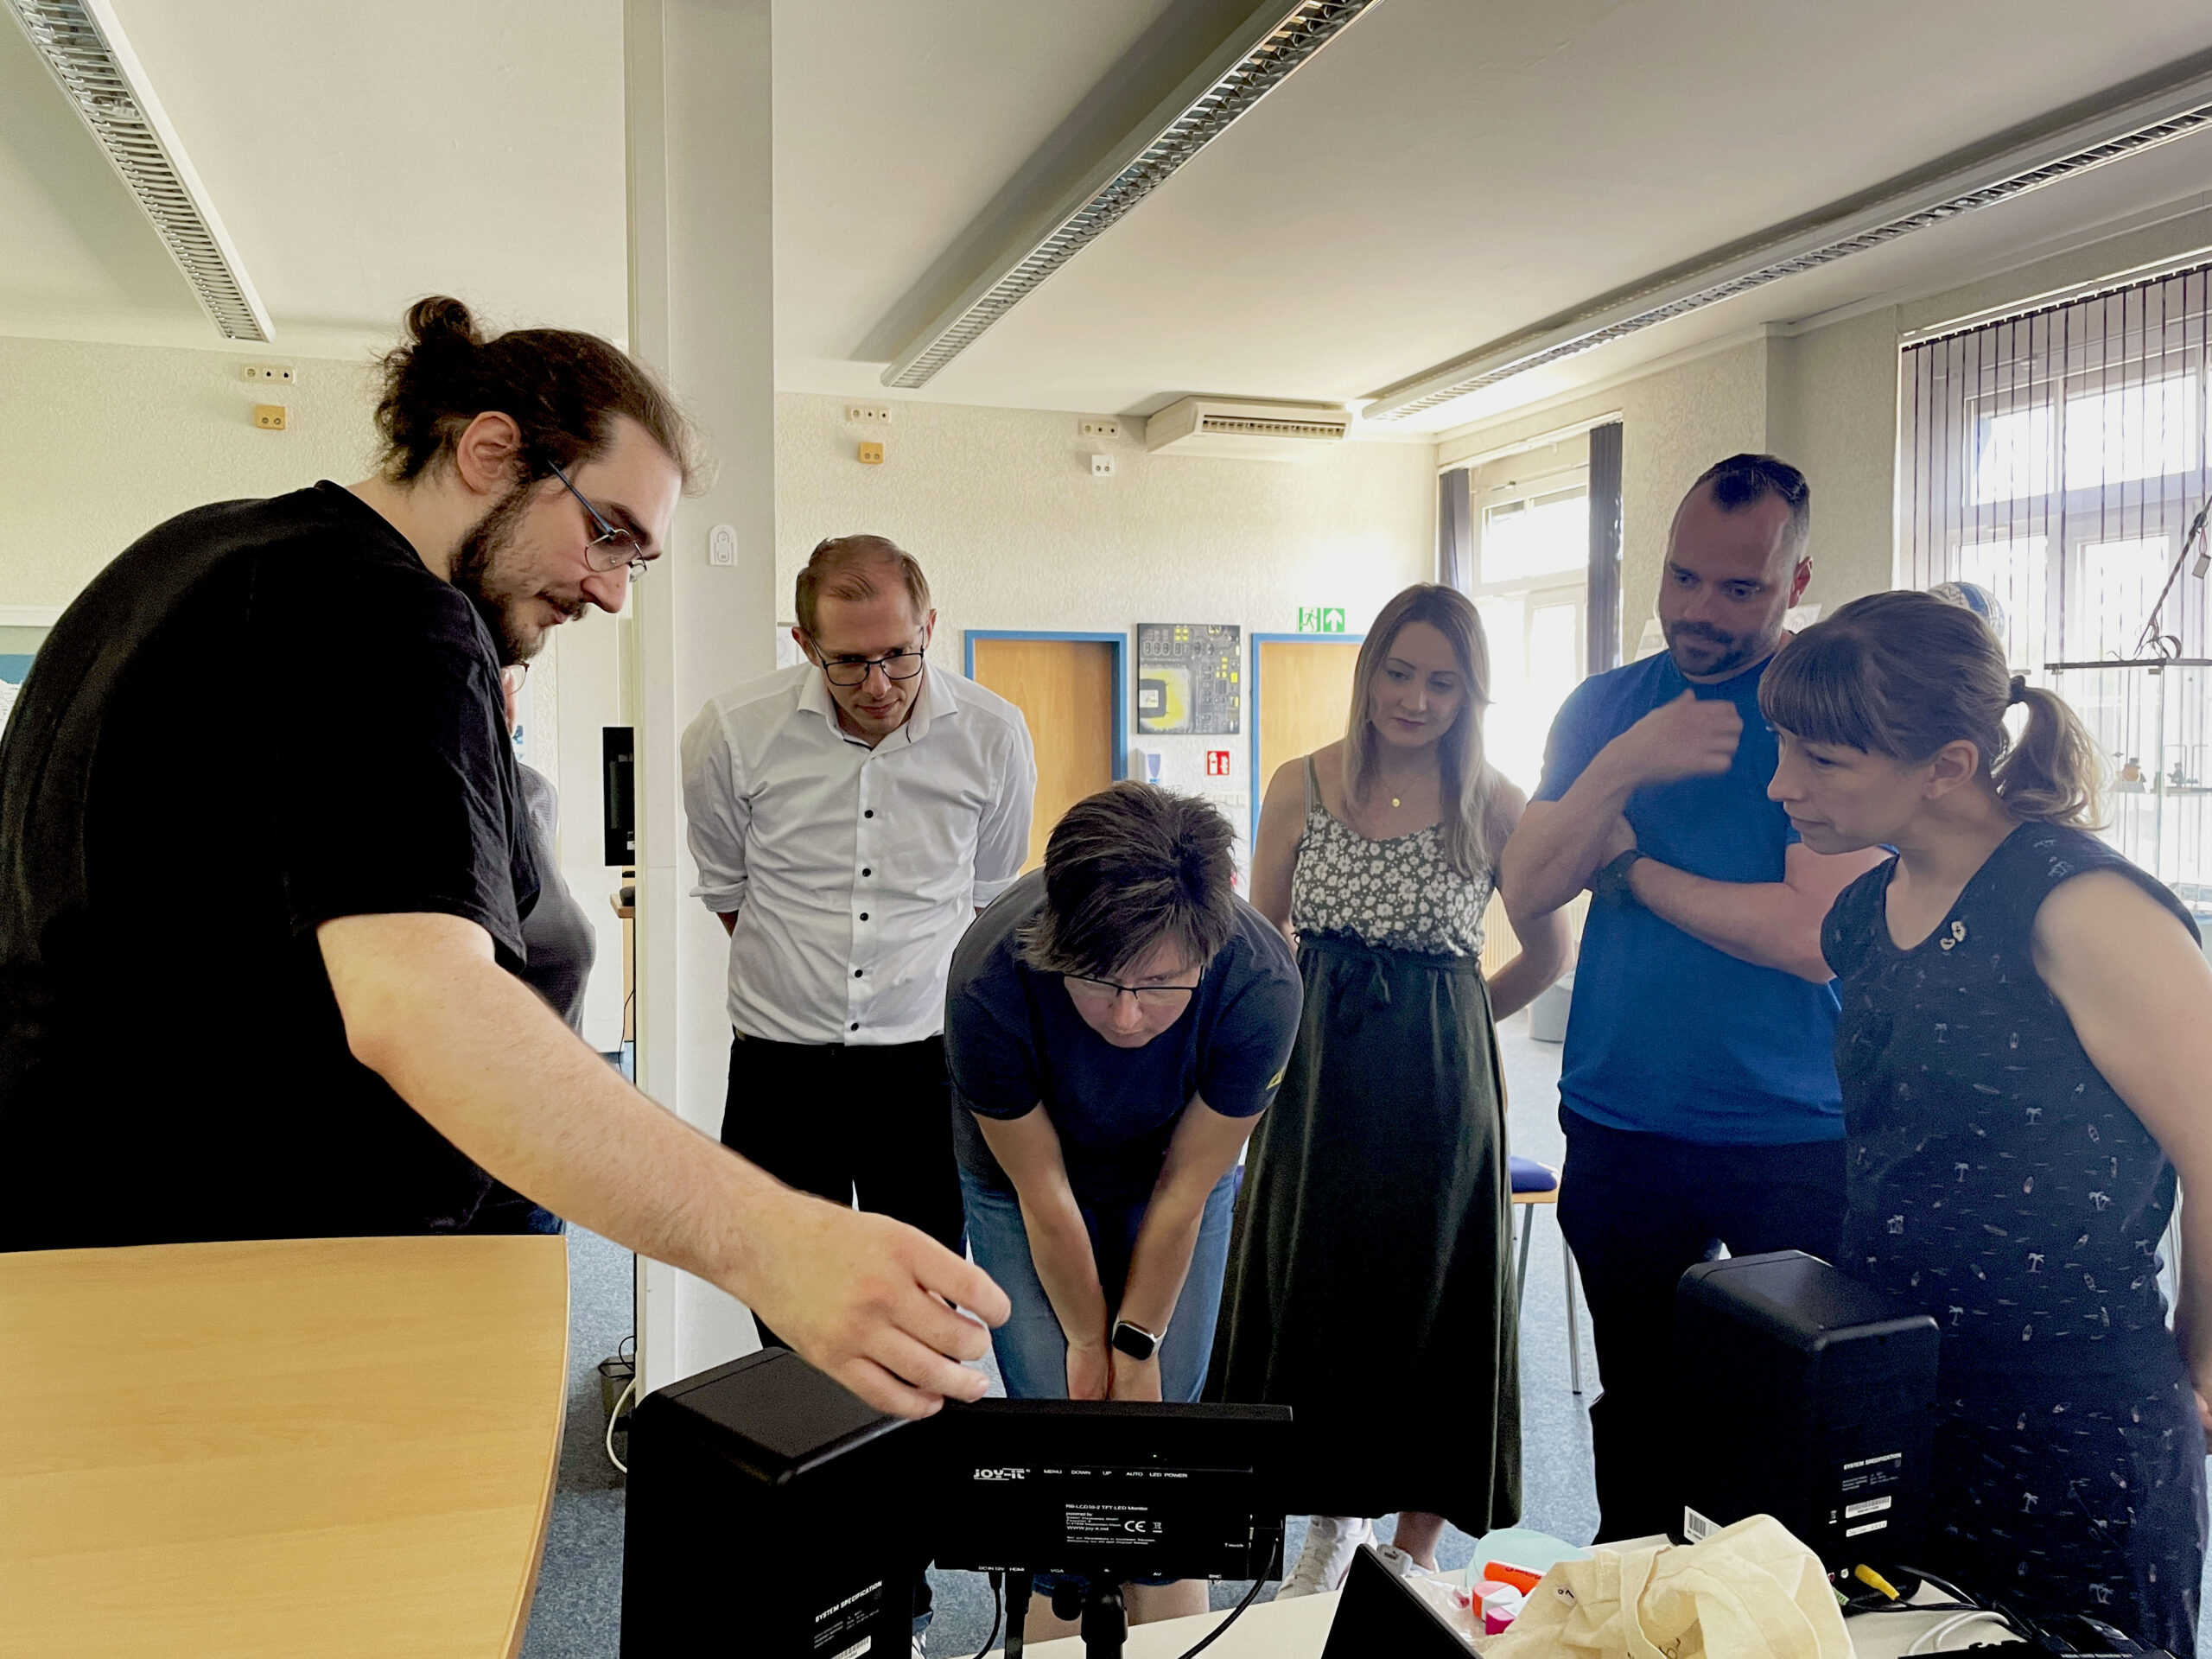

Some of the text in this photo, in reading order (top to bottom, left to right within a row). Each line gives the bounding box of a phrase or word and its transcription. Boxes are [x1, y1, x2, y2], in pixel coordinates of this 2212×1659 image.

[1843, 1452, 1903, 1471] SYSTEM SPECIFICATION
[815, 1604, 840, 1623] SYSTEM
[840, 1580, 883, 1609] SPECIFICATION
